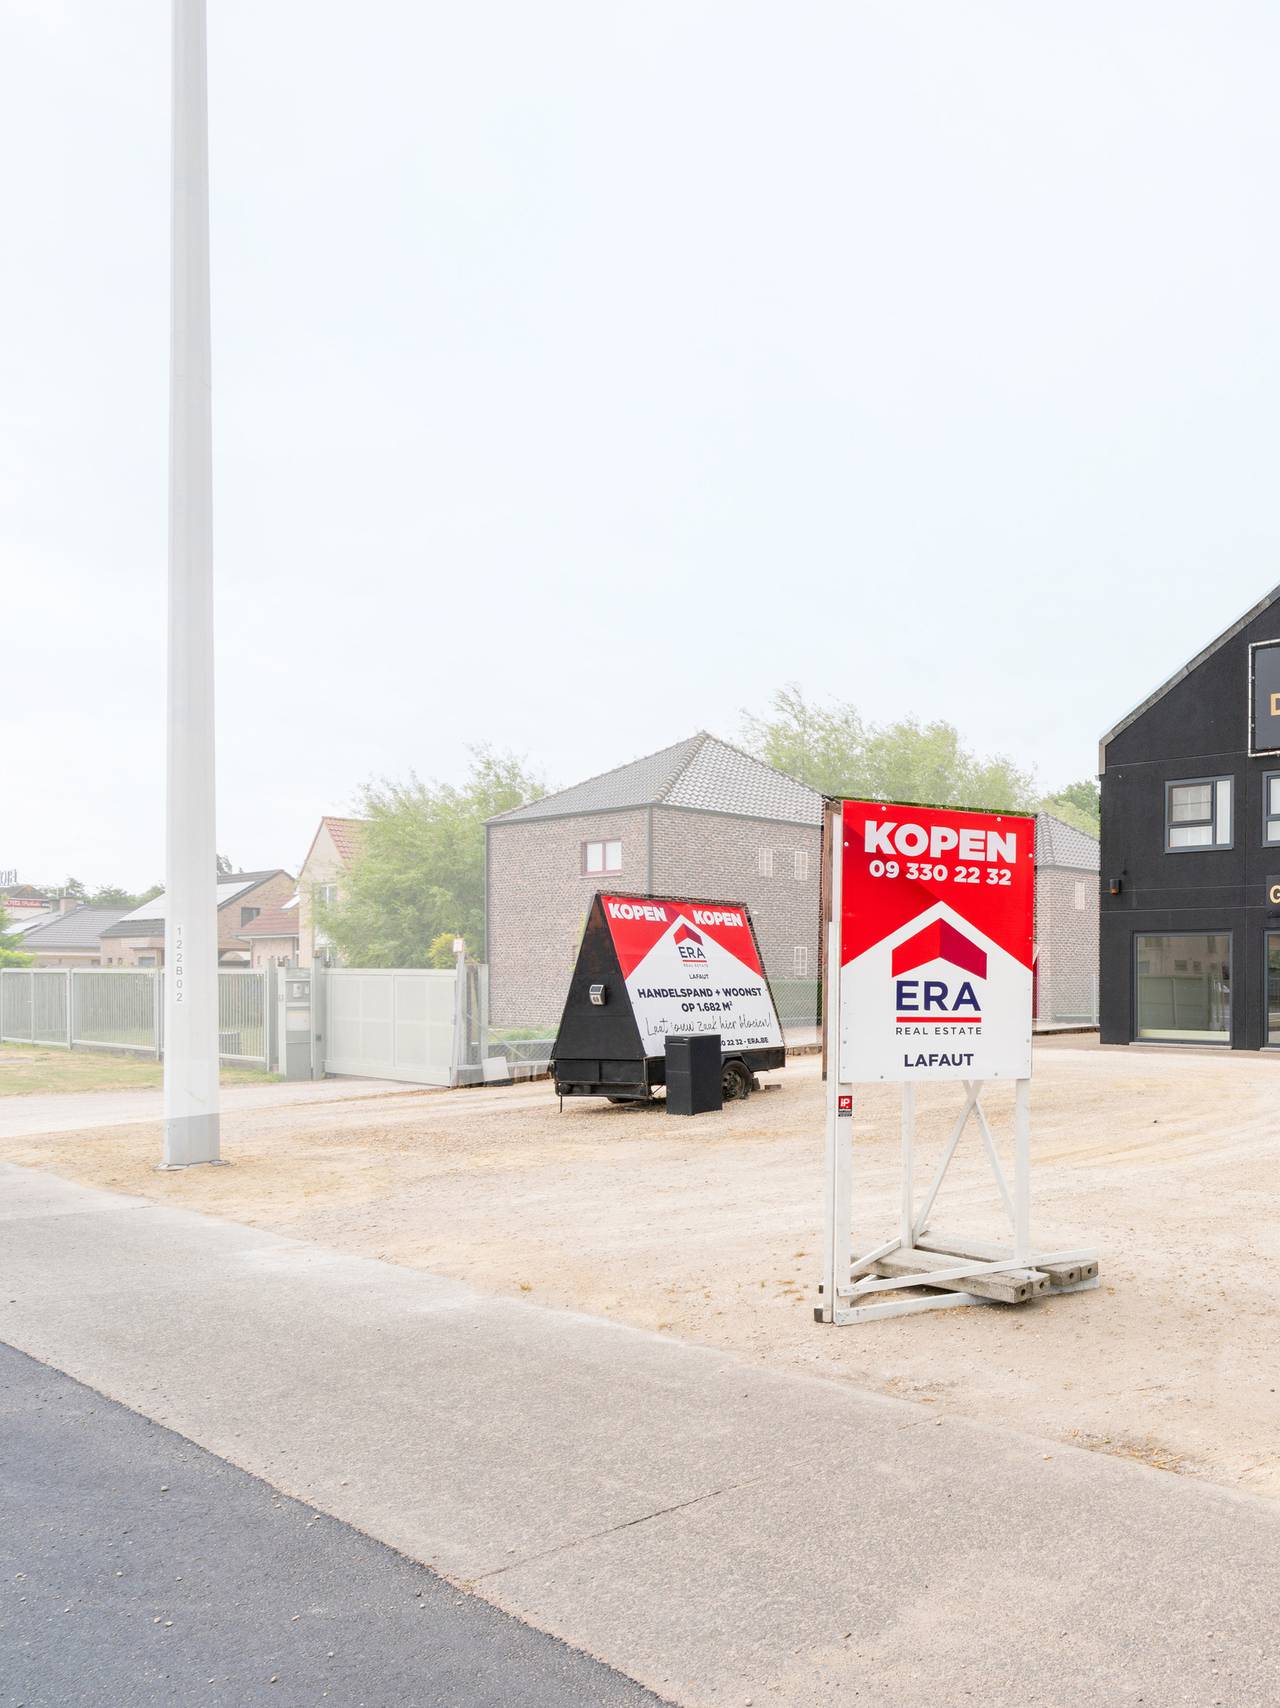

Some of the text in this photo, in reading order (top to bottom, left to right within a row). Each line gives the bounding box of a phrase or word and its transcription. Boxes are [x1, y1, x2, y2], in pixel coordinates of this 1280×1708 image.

[864, 819, 1017, 864] KOPEN
[869, 859, 1012, 886] 09 330 22 32
[608, 902, 668, 922] KOPEN
[692, 909, 744, 927] KOPEN
[678, 946, 707, 959] ERA
[637, 988, 713, 999] HANDELSPAND
[723, 987, 762, 997] WOONST
[896, 980, 982, 1011] ERA
[681, 1002, 695, 1012] OP
[698, 1002, 721, 1012] 1.682
[645, 1017, 669, 1037] Laat
[719, 1015, 737, 1030] hier
[895, 1026, 982, 1035] REAL ESTATE
[735, 1038, 743, 1046] 32
[904, 1053, 975, 1067] LAFAUT
